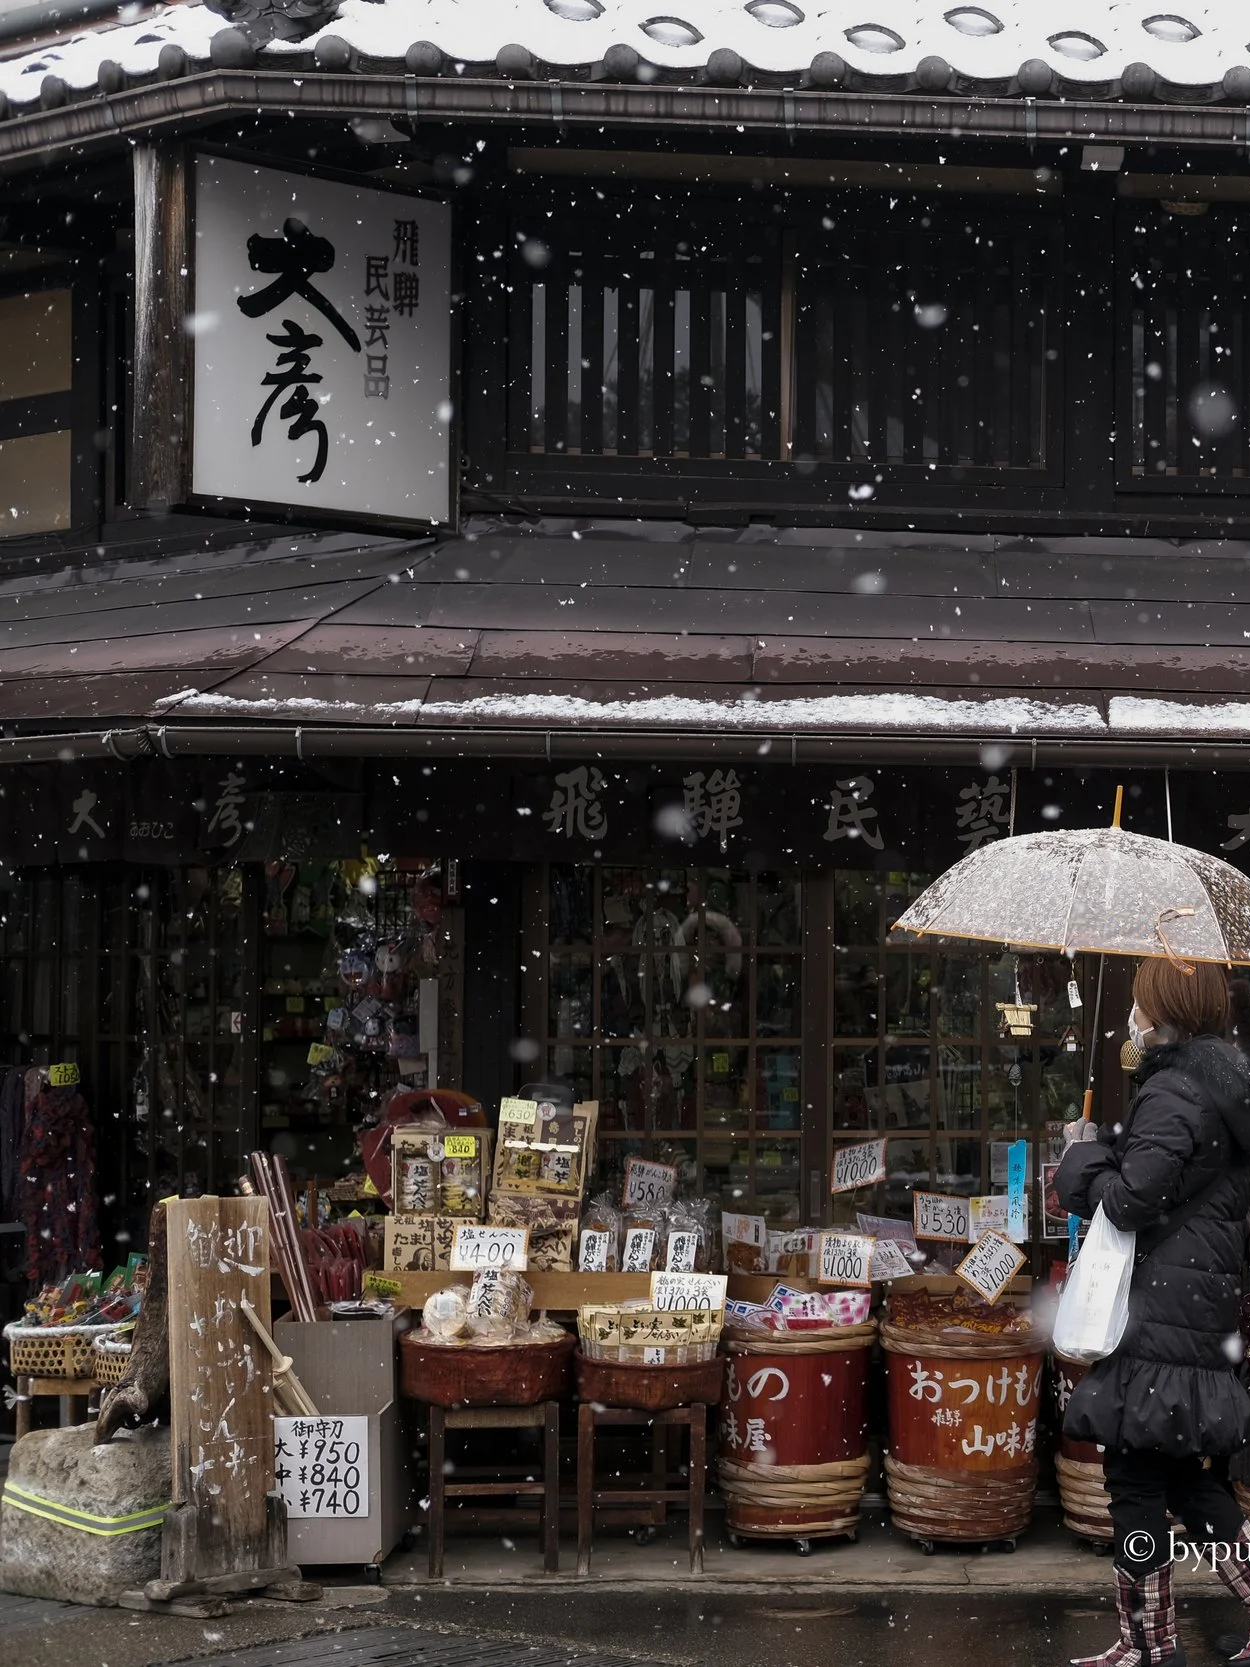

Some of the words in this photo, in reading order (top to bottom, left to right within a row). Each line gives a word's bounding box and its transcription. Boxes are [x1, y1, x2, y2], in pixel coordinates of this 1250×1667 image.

[364, 255, 391, 400] 民芸品
[129, 820, 175, 839] おおひこ
[459, 1228, 523, 1241] 塩せんべい
[921, 1212, 967, 1235] ¥530
[459, 1241, 516, 1265] ¥400
[291, 1419, 345, 1439] 御守刀
[299, 1438, 360, 1464] ¥950
[298, 1464, 361, 1489] ¥840
[299, 1488, 361, 1515] ¥740
